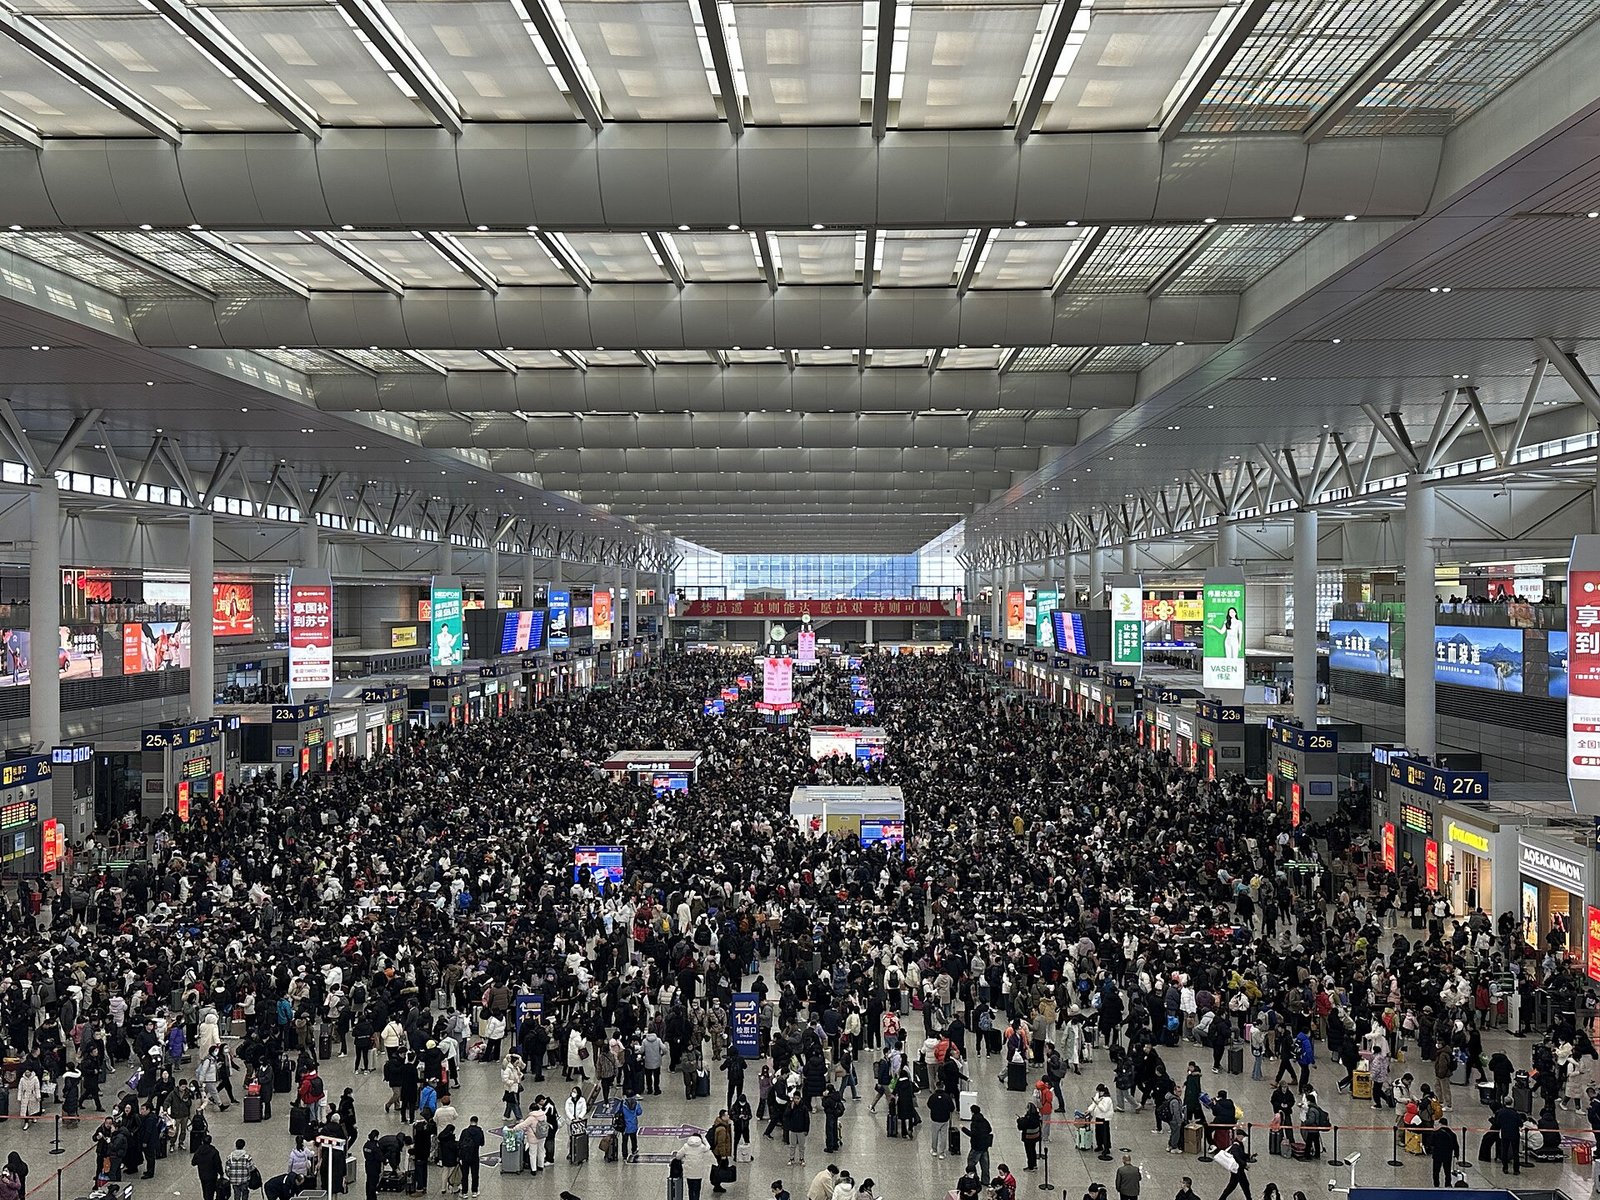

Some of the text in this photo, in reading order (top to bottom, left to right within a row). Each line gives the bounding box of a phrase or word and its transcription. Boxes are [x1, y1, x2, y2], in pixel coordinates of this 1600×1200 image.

[293, 615, 328, 627] 到苏宁
[1575, 631, 1600, 655] 到
[481, 668, 494, 676] 17A
[1210, 665, 1238, 673] VASEN
[432, 678, 446, 687] 19A
[365, 691, 381, 700] 21A
[1161, 691, 1178, 701] 21B
[275, 709, 294, 719] 23A
[1222, 710, 1241, 720] 23B
[146, 734, 168, 747] 25A
[1310, 736, 1333, 748] 25B
[1578, 739, 1600, 749] 全国
[37, 760, 52, 776] 26A
[1433, 775, 1446, 792] 27B
[1452, 778, 1483, 794] 27B
[735, 1013, 757, 1025] 1-21
